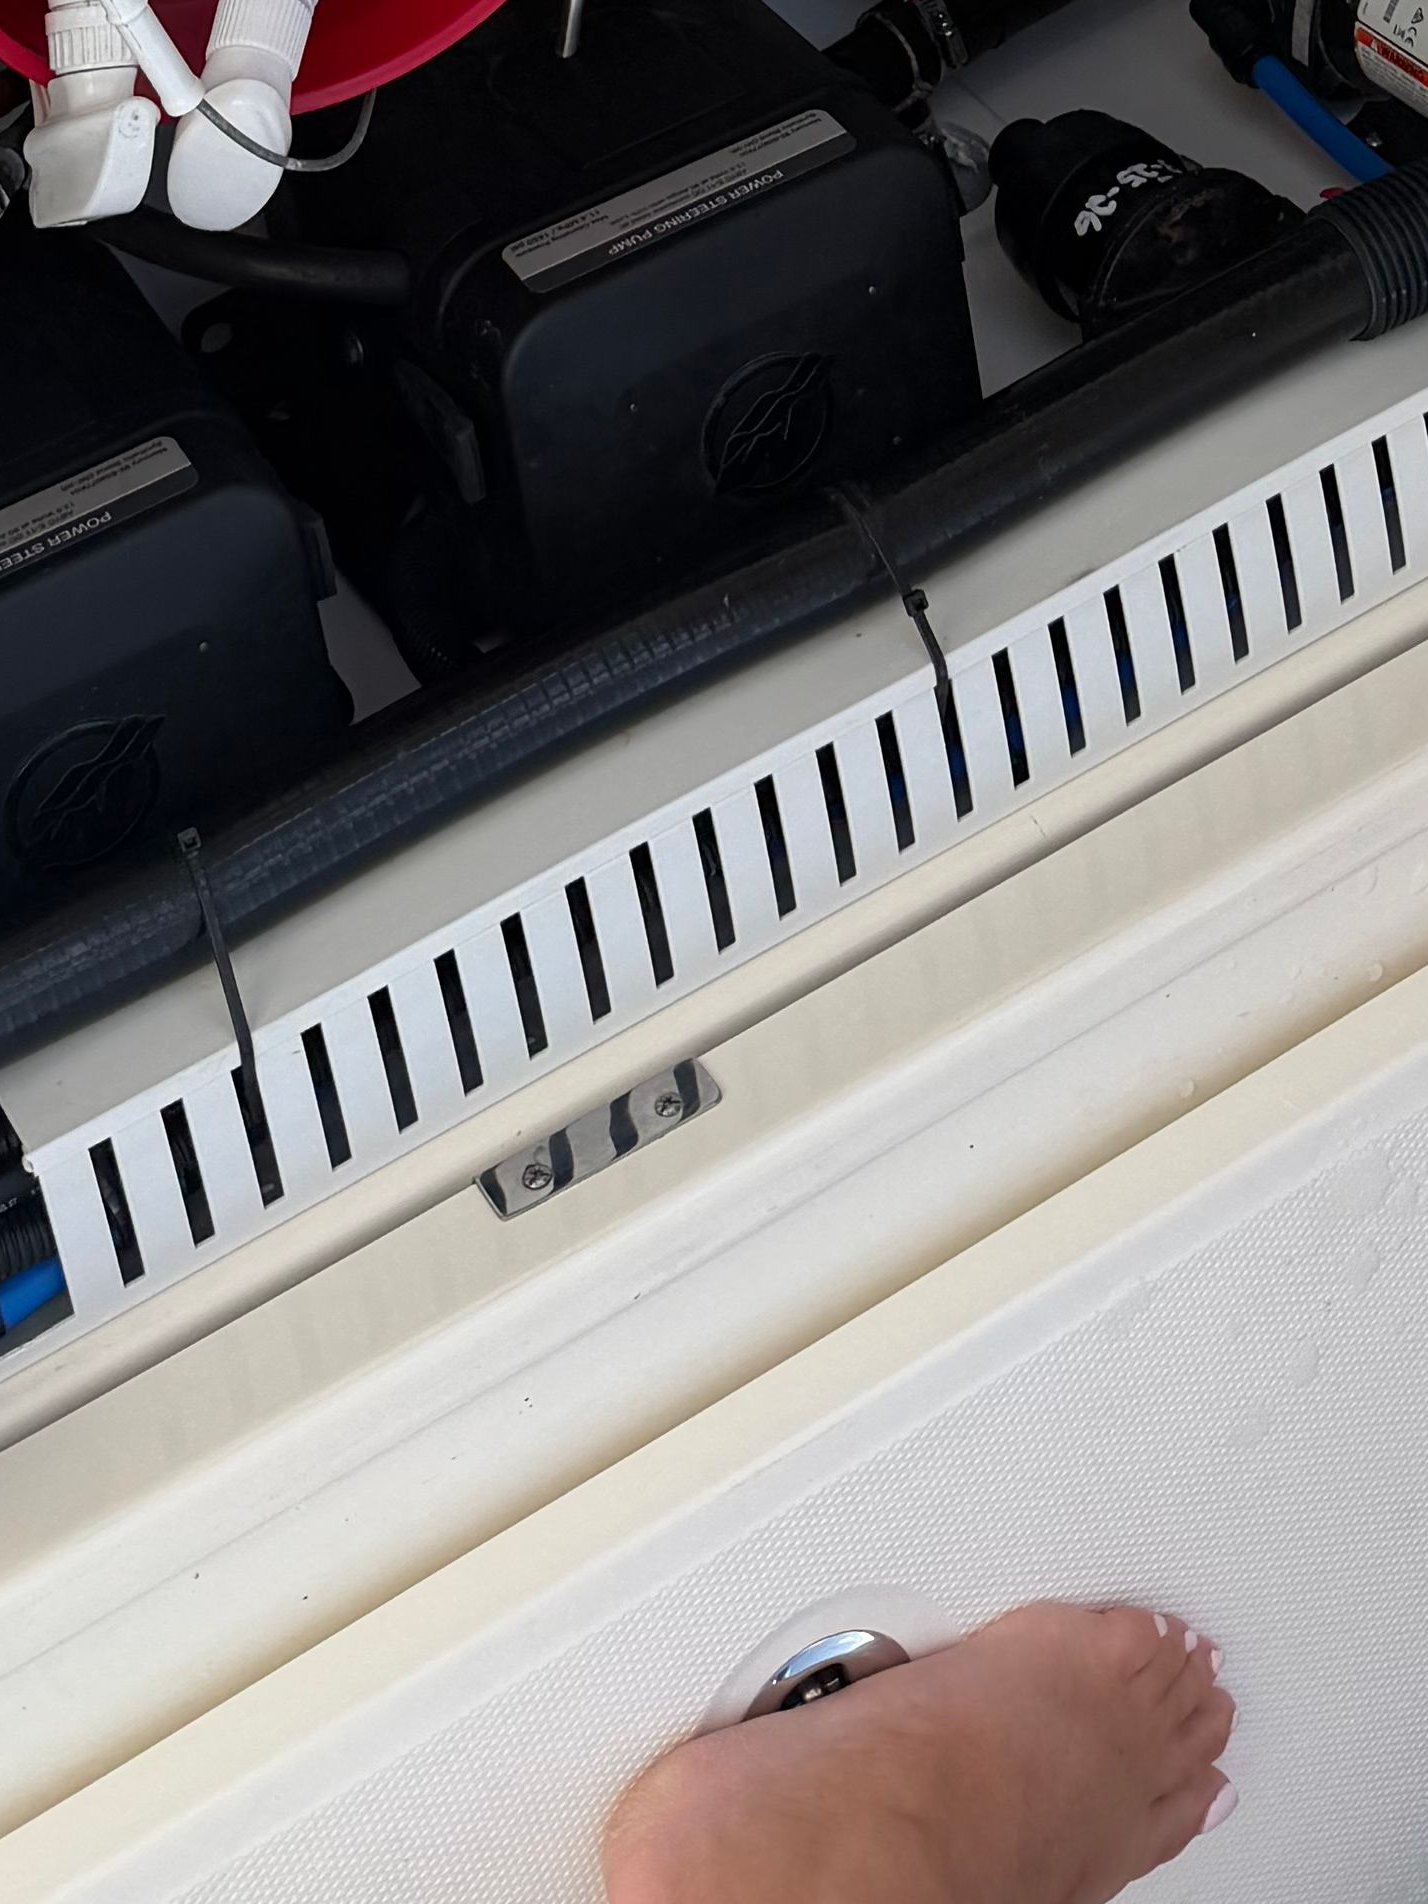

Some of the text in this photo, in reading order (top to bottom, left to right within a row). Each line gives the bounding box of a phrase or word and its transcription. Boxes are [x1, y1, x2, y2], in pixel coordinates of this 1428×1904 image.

[727, 166, 784, 201] POWER
[652, 191, 728, 235] STEERING
[605, 226, 652, 257] PUMP
[45, 509, 113, 549] POWER
